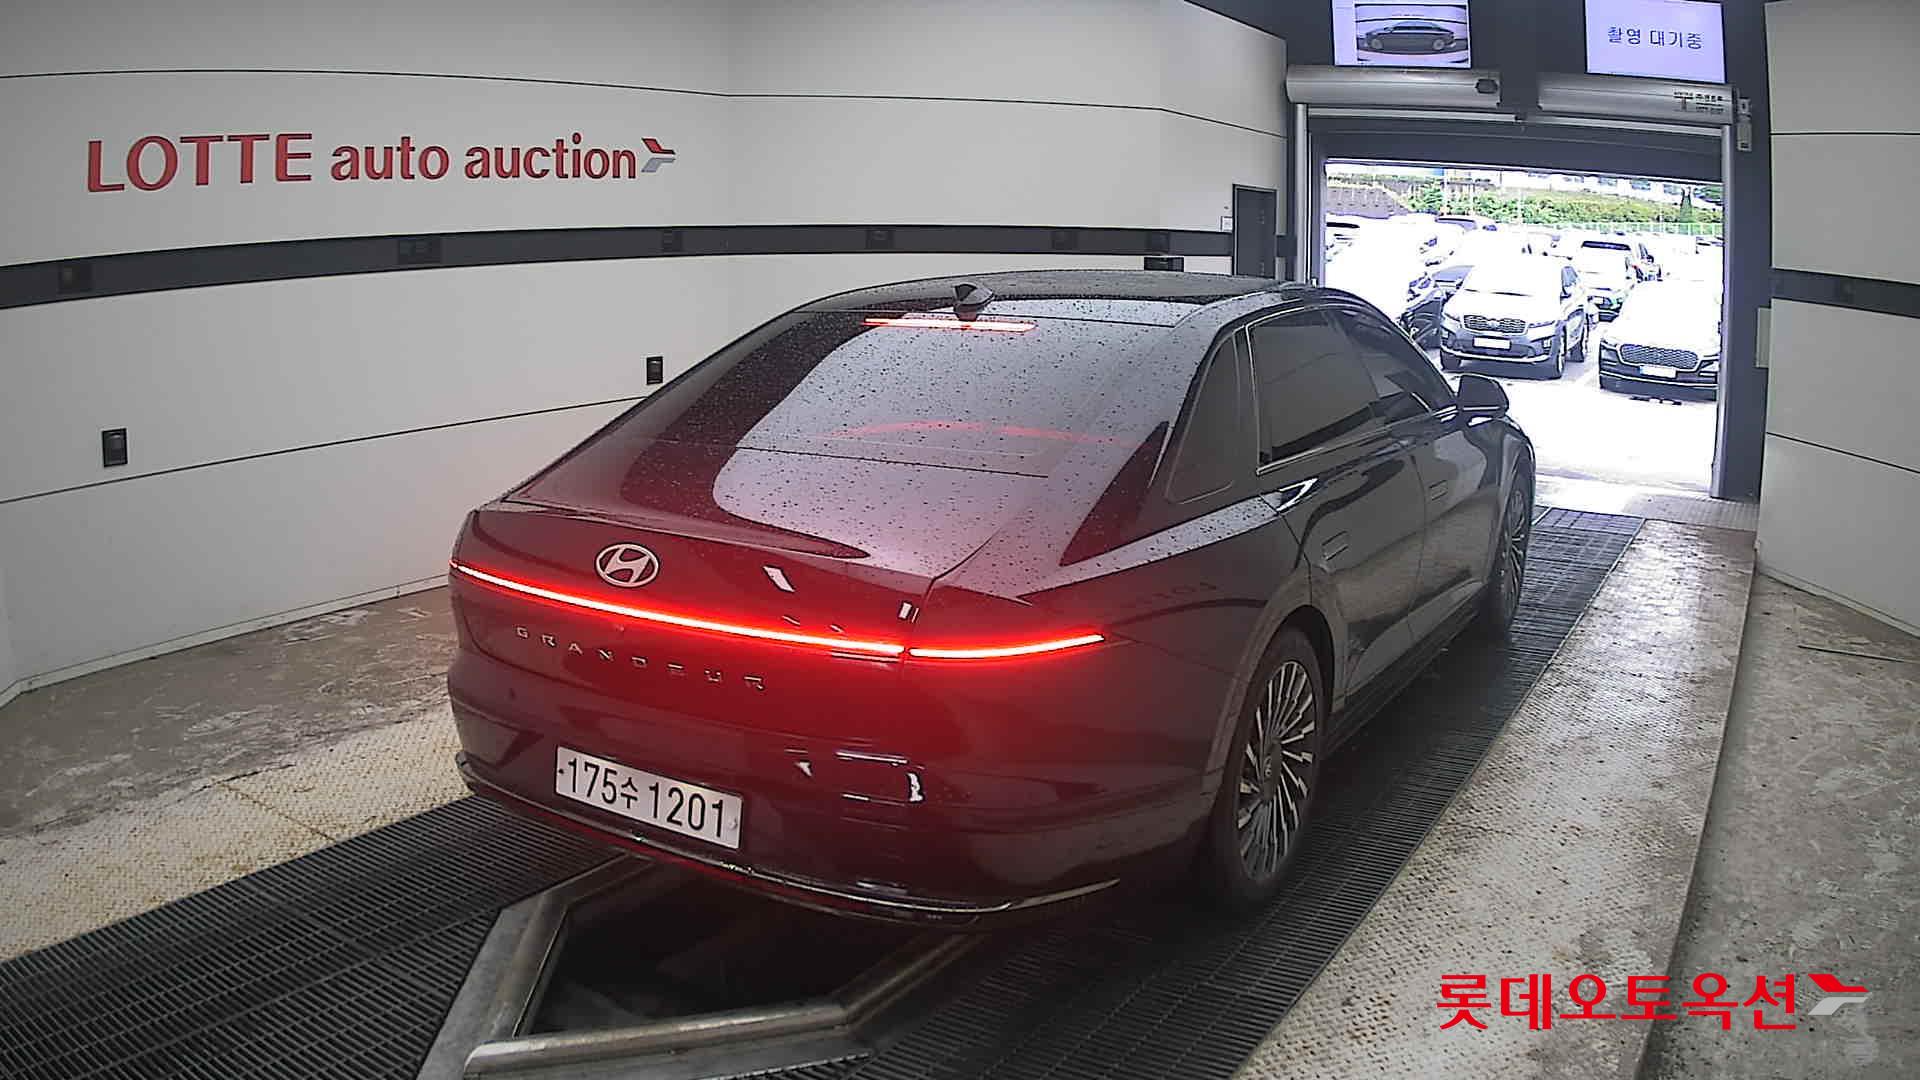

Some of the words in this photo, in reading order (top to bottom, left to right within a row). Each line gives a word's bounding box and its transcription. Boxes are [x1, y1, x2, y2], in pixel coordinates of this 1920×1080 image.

[1607, 25, 1642, 45] 촬영
[1649, 29, 1703, 51] 대기중
[87, 132, 313, 193] LOTTE
[330, 136, 450, 181] auto
[463, 131, 637, 180] auction
[515, 625, 766, 692] GRANDEUR
[567, 756, 639, 810] 175수
[648, 781, 724, 839] 1201
